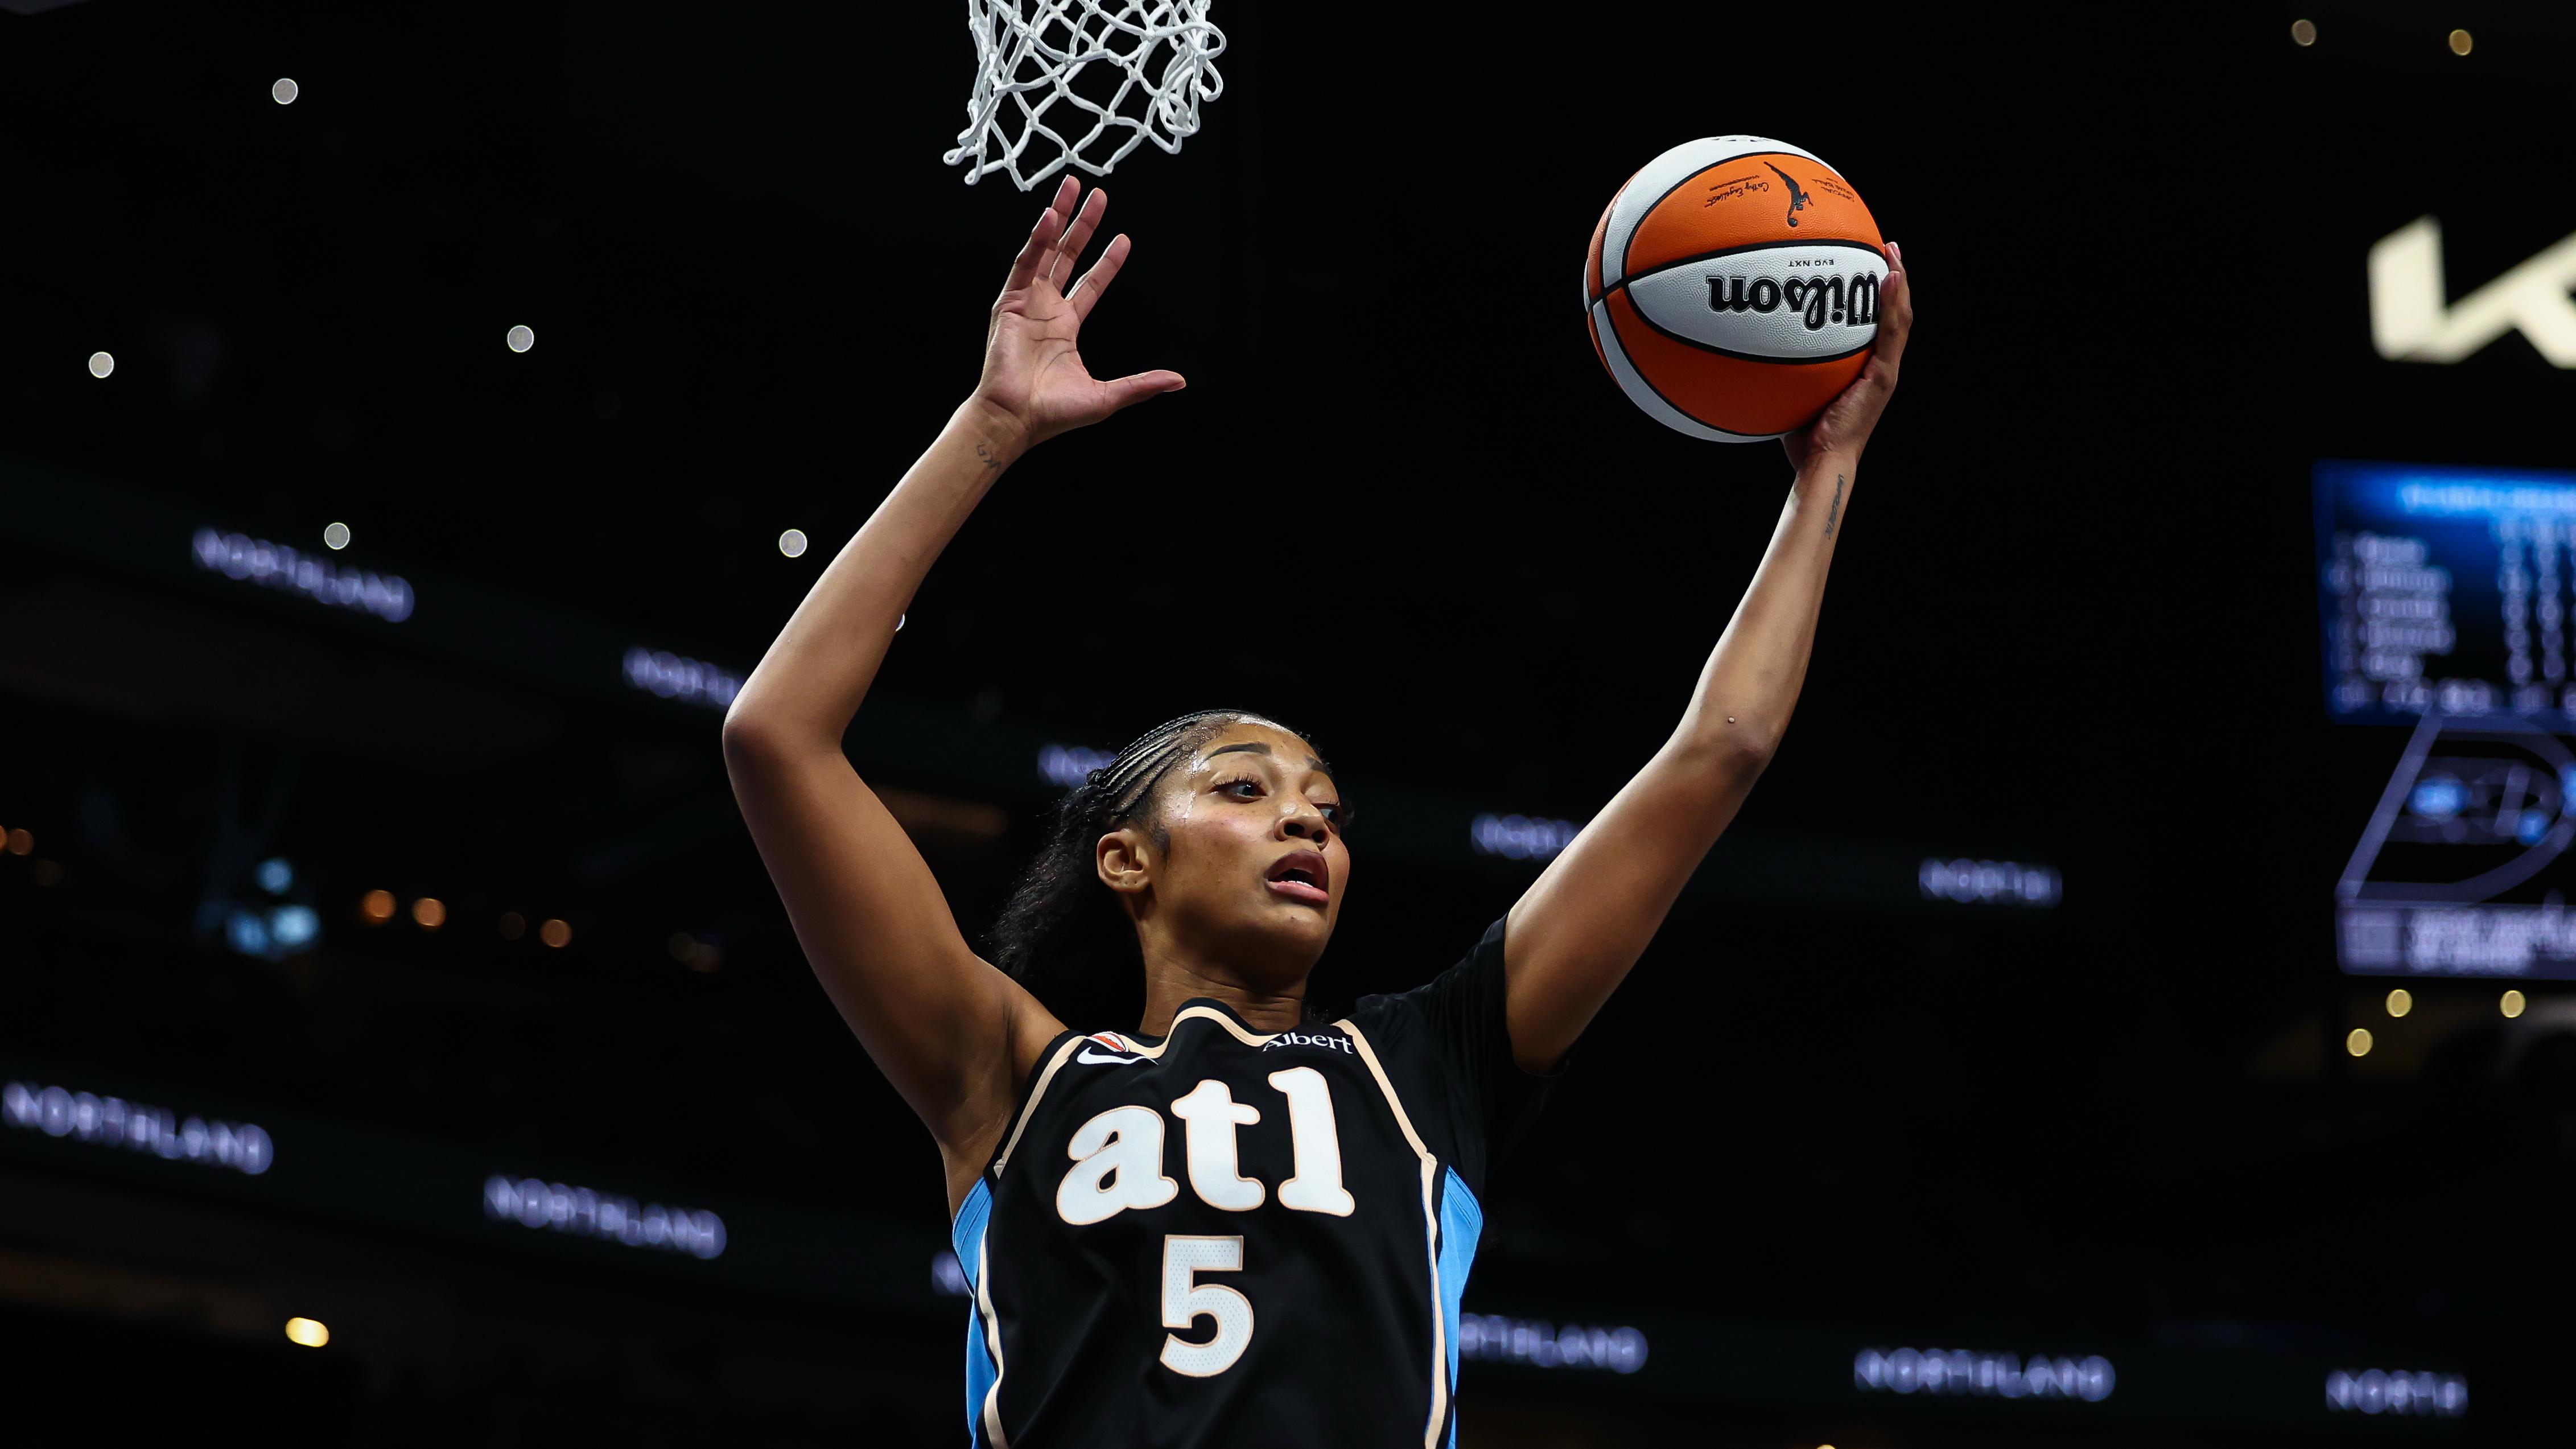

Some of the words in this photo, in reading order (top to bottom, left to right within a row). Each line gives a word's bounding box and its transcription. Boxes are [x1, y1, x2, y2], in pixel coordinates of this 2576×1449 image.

[1706, 271, 1879, 331] Wilson
[1262, 1032, 1353, 1054] Albert
[3, 1083, 273, 1174] NORTHLAND
[1056, 1066, 1355, 1225] atl
[484, 1176, 726, 1258] NORTHLAND
[1160, 1234, 1254, 1378] 5
[1459, 1312, 1647, 1373] RTHLAND
[1854, 1348, 2115, 1401] NORTHLAND
